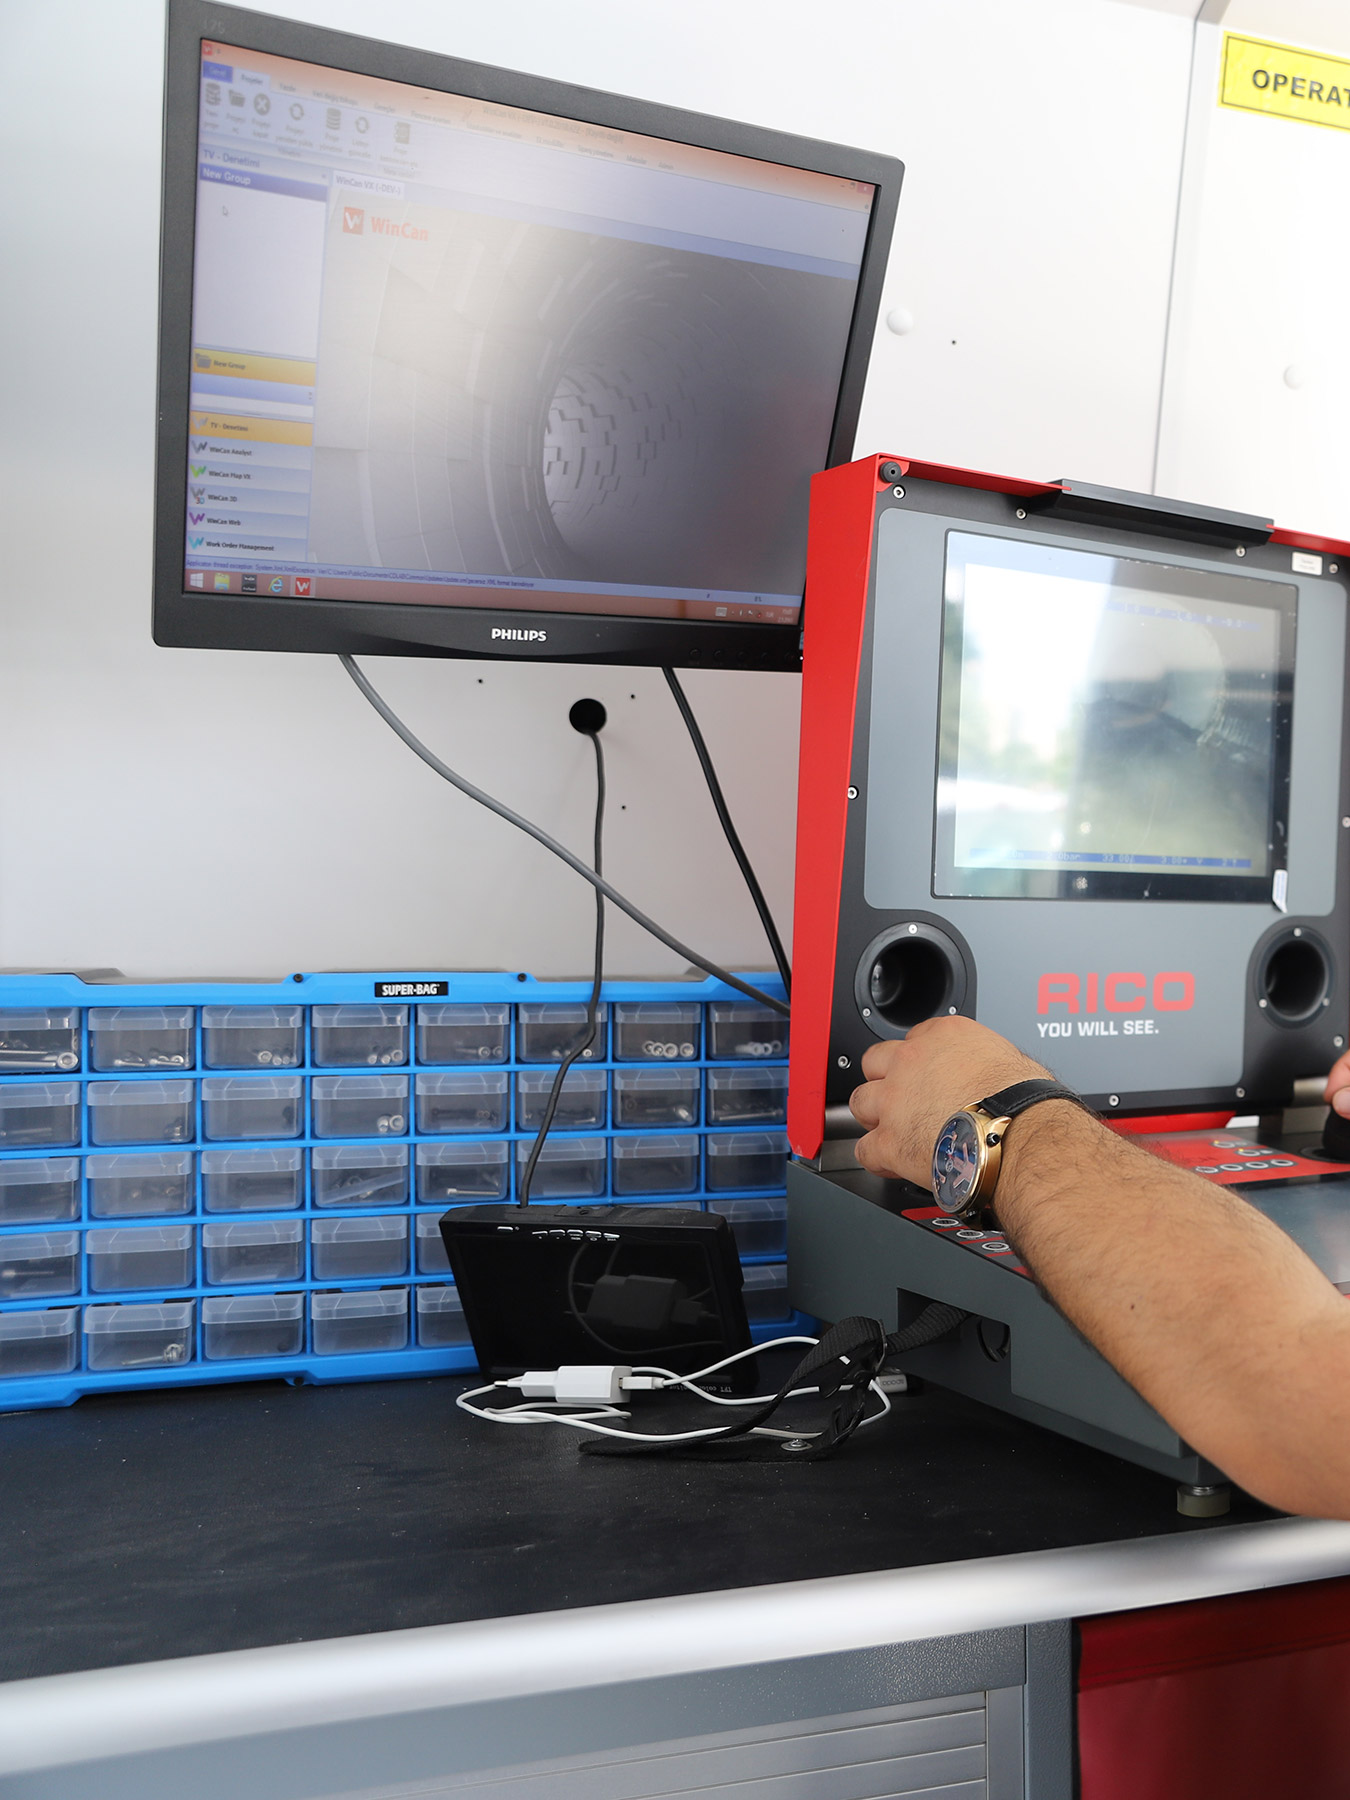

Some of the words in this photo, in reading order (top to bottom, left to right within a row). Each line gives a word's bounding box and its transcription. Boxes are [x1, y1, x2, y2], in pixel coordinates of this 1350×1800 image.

[203, 149, 215, 160] TV
[203, 168, 222, 181] New
[224, 172, 252, 186] Group
[371, 216, 429, 241] WinCan
[491, 628, 547, 642] PHILIPS
[1036, 971, 1195, 1015] RICO
[1037, 1021, 1072, 1038] YOU
[1077, 1020, 1119, 1037] WILL
[1123, 1019, 1160, 1036] SEE.
